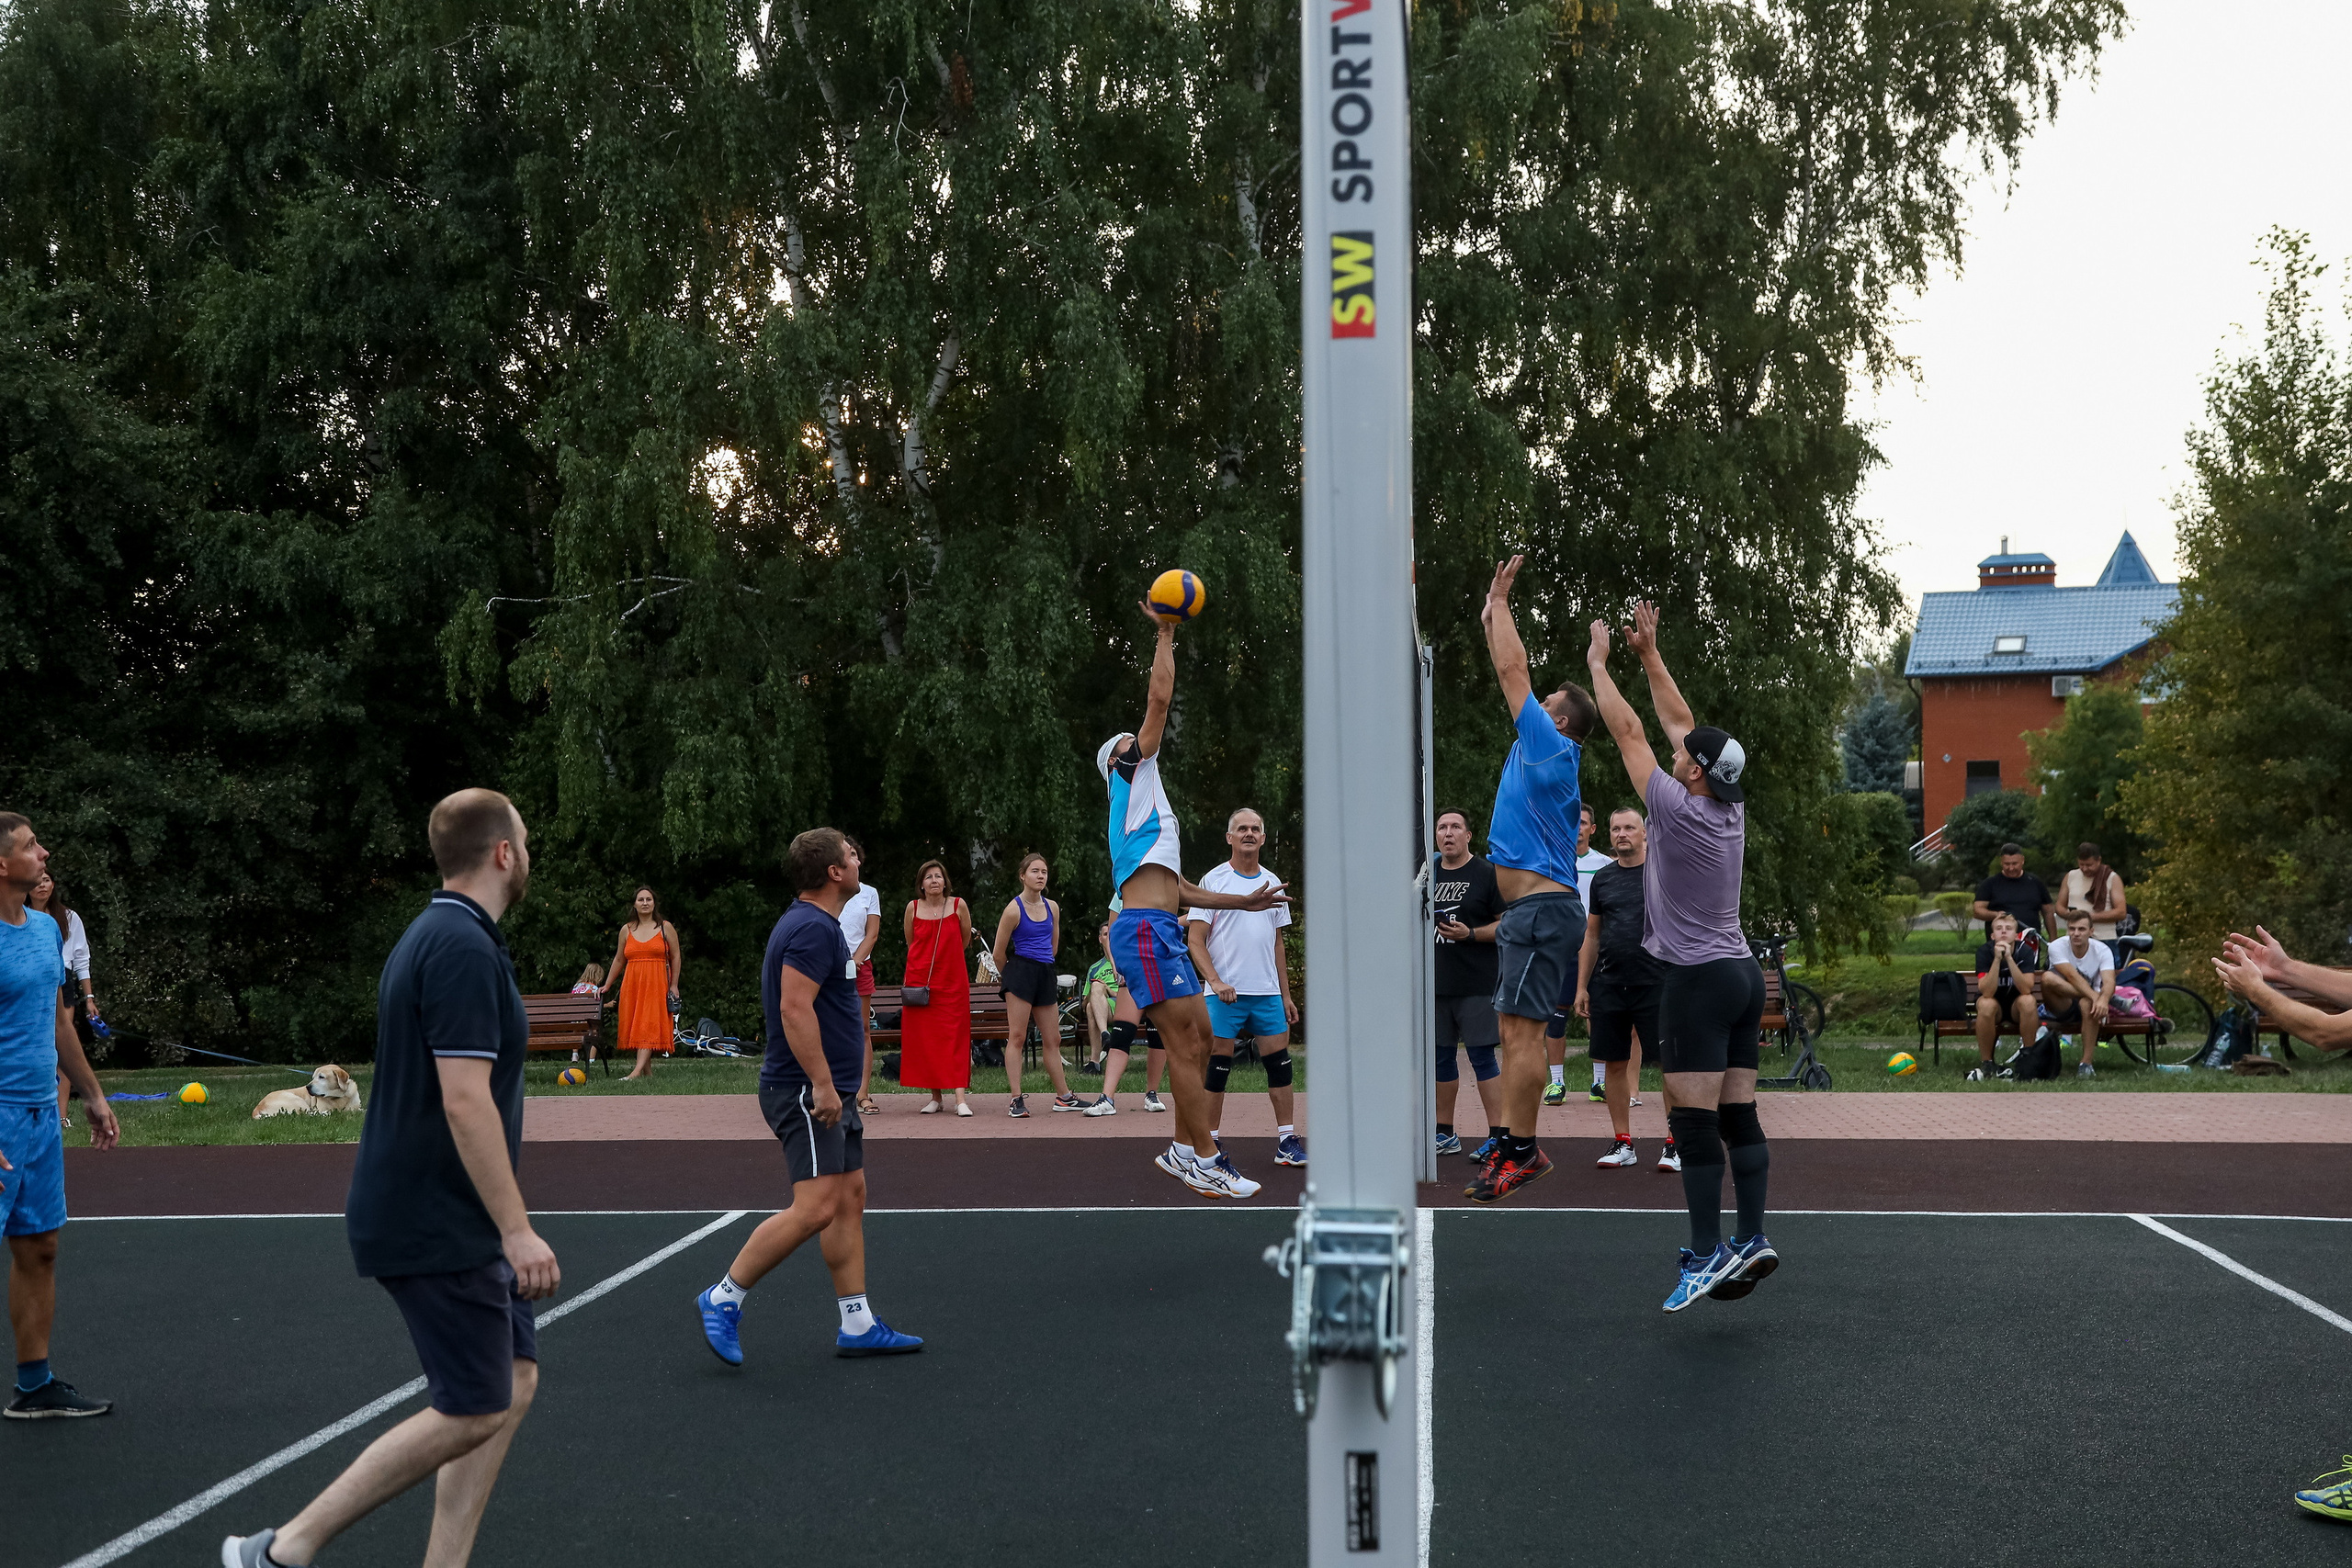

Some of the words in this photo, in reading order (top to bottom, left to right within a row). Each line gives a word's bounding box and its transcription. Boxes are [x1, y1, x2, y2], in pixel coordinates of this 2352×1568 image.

[1332, 235, 1374, 325] SW
[721, 1281, 732, 1293] 23
[846, 1303, 862, 1314] 23
